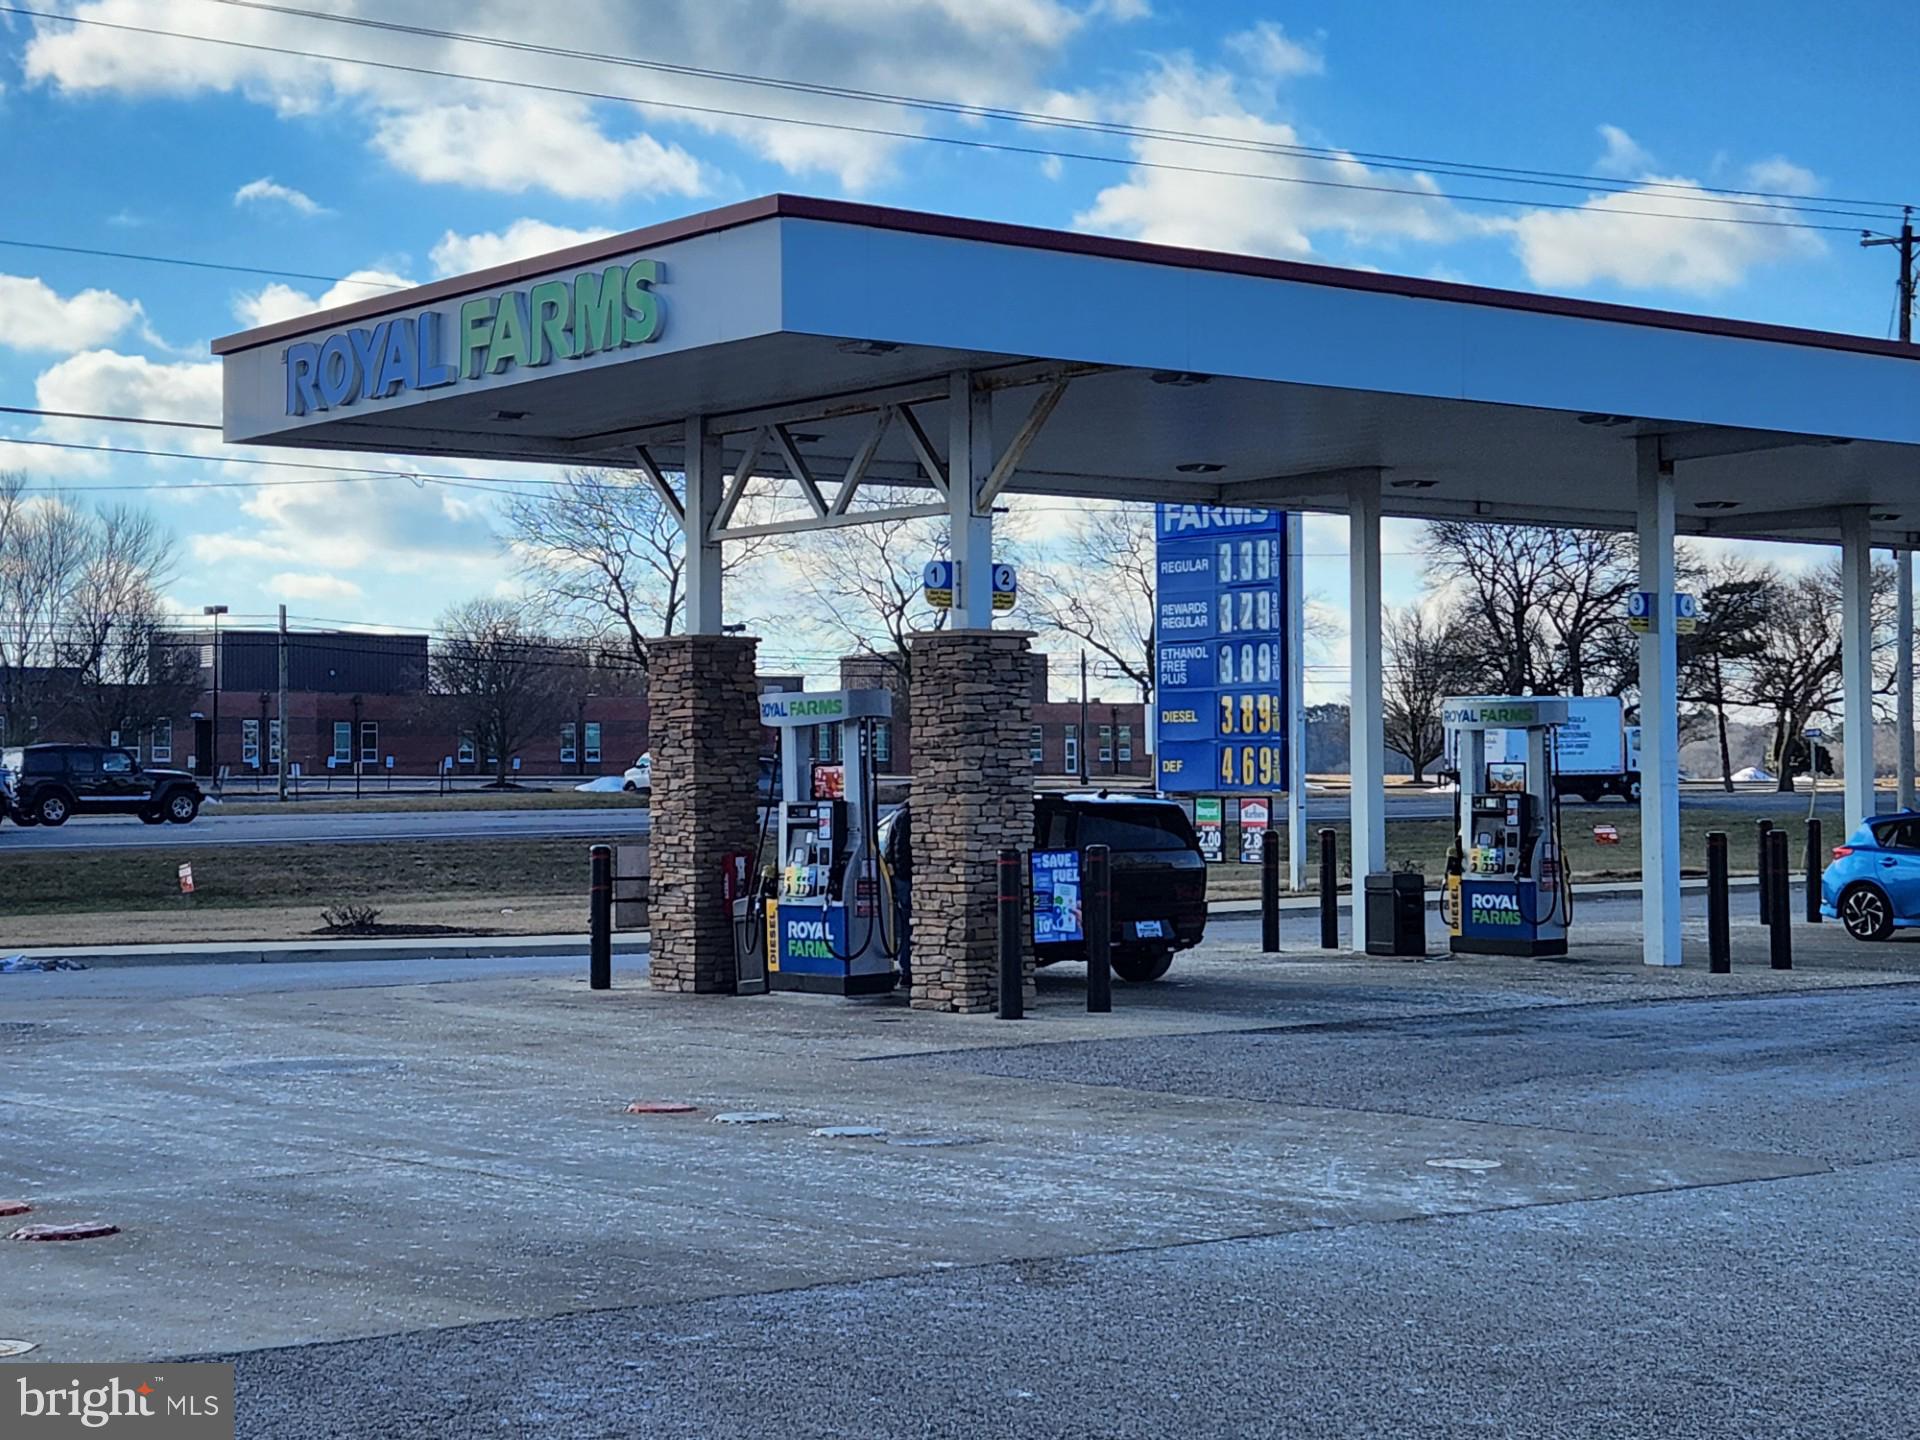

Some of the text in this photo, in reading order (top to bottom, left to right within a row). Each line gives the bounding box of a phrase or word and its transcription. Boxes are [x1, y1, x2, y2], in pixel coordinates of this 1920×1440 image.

[285, 259, 669, 416] ROYAL FARMS
[1161, 559, 1208, 574] REGULAR
[1220, 540, 1270, 583] 3.39
[931, 567, 938, 582] 1
[1001, 571, 1009, 585] 2
[1161, 602, 1207, 616] REWARDS
[1220, 591, 1270, 633] 3.29
[1161, 616, 1208, 629] REGULAR
[1161, 647, 1208, 659] ETHANOL
[1161, 660, 1187, 673] FREE
[1220, 643, 1270, 684] 3.89
[1161, 674, 1187, 685] PLUS
[790, 700, 842, 716] FARMS
[1221, 694, 1271, 733] 3.89
[1444, 708, 1533, 722] ROYAL FARMS
[1162, 711, 1198, 723] DIESEL
[1162, 761, 1183, 773] DEF
[1222, 747, 1272, 785] 4.69
[1052, 869, 1080, 882] FUEL
[1451, 885, 1459, 930] DIESEL
[1472, 893, 1519, 910] ROYAL
[1472, 909, 1521, 925] FARMS
[787, 920, 834, 940] ROYAL
[769, 912, 777, 964] DIESEL
